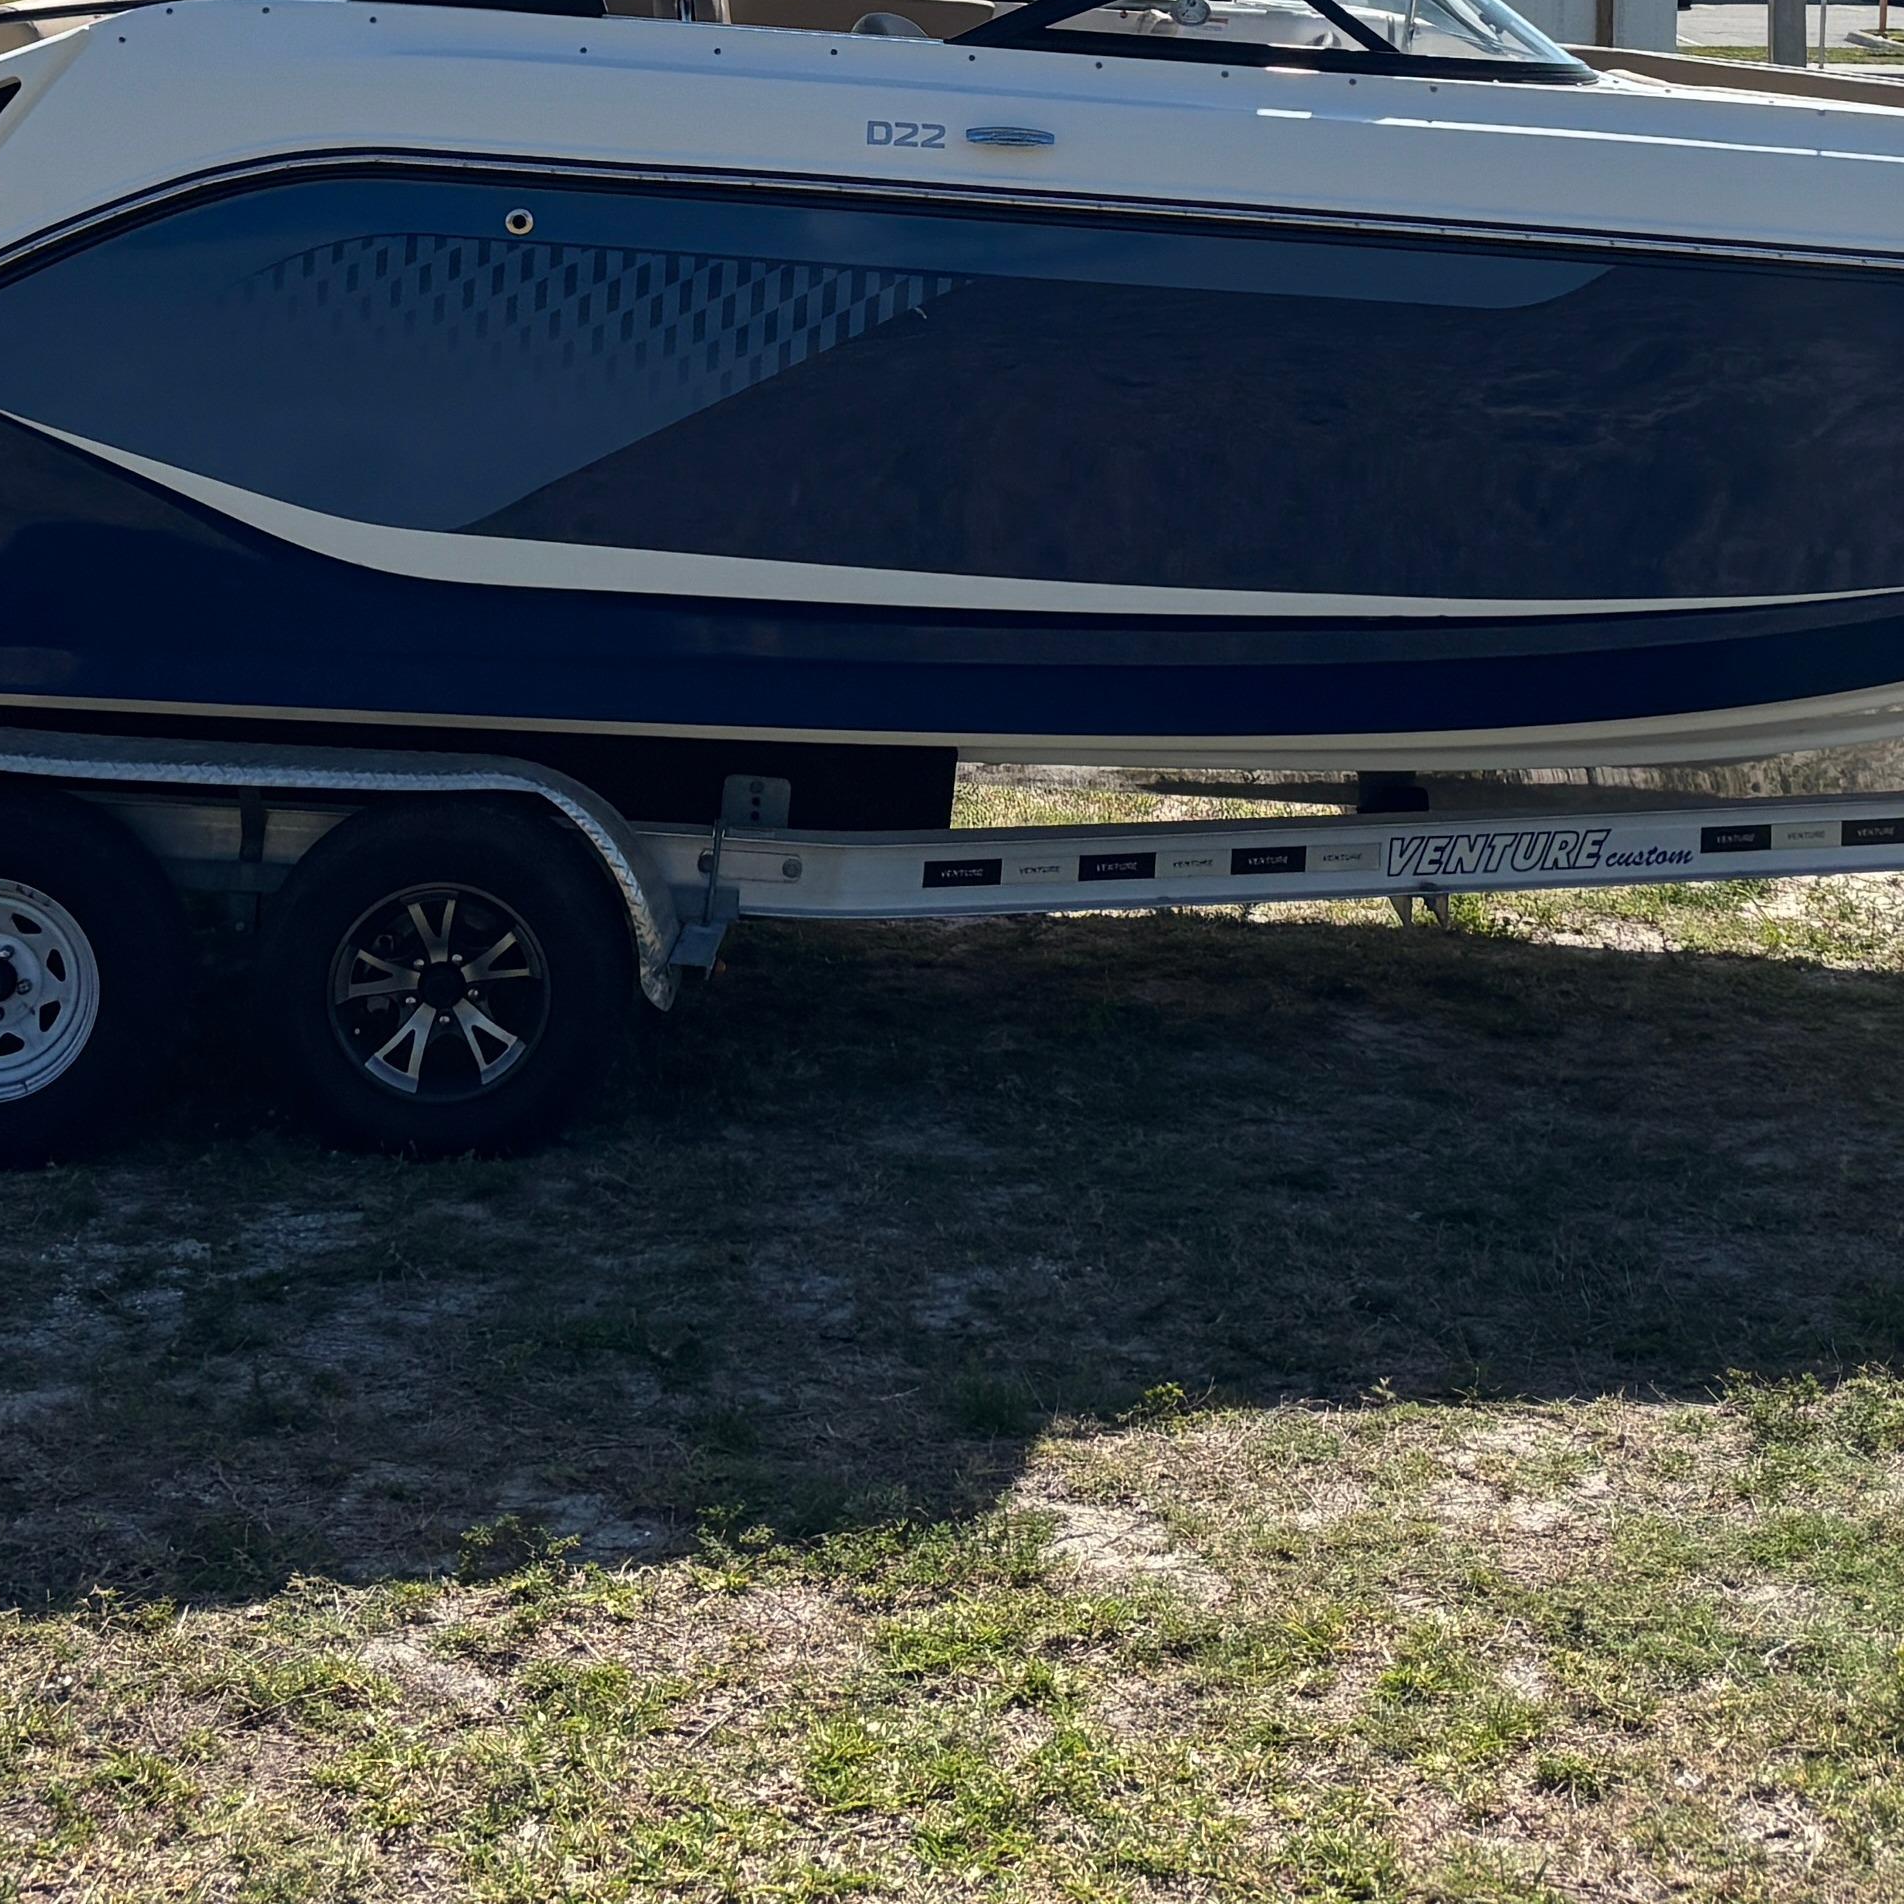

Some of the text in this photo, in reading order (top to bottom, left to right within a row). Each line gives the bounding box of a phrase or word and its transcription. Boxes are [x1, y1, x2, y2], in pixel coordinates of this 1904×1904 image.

[866, 120, 946, 149] D22
[1386, 828, 1694, 877] VENTURE custom
